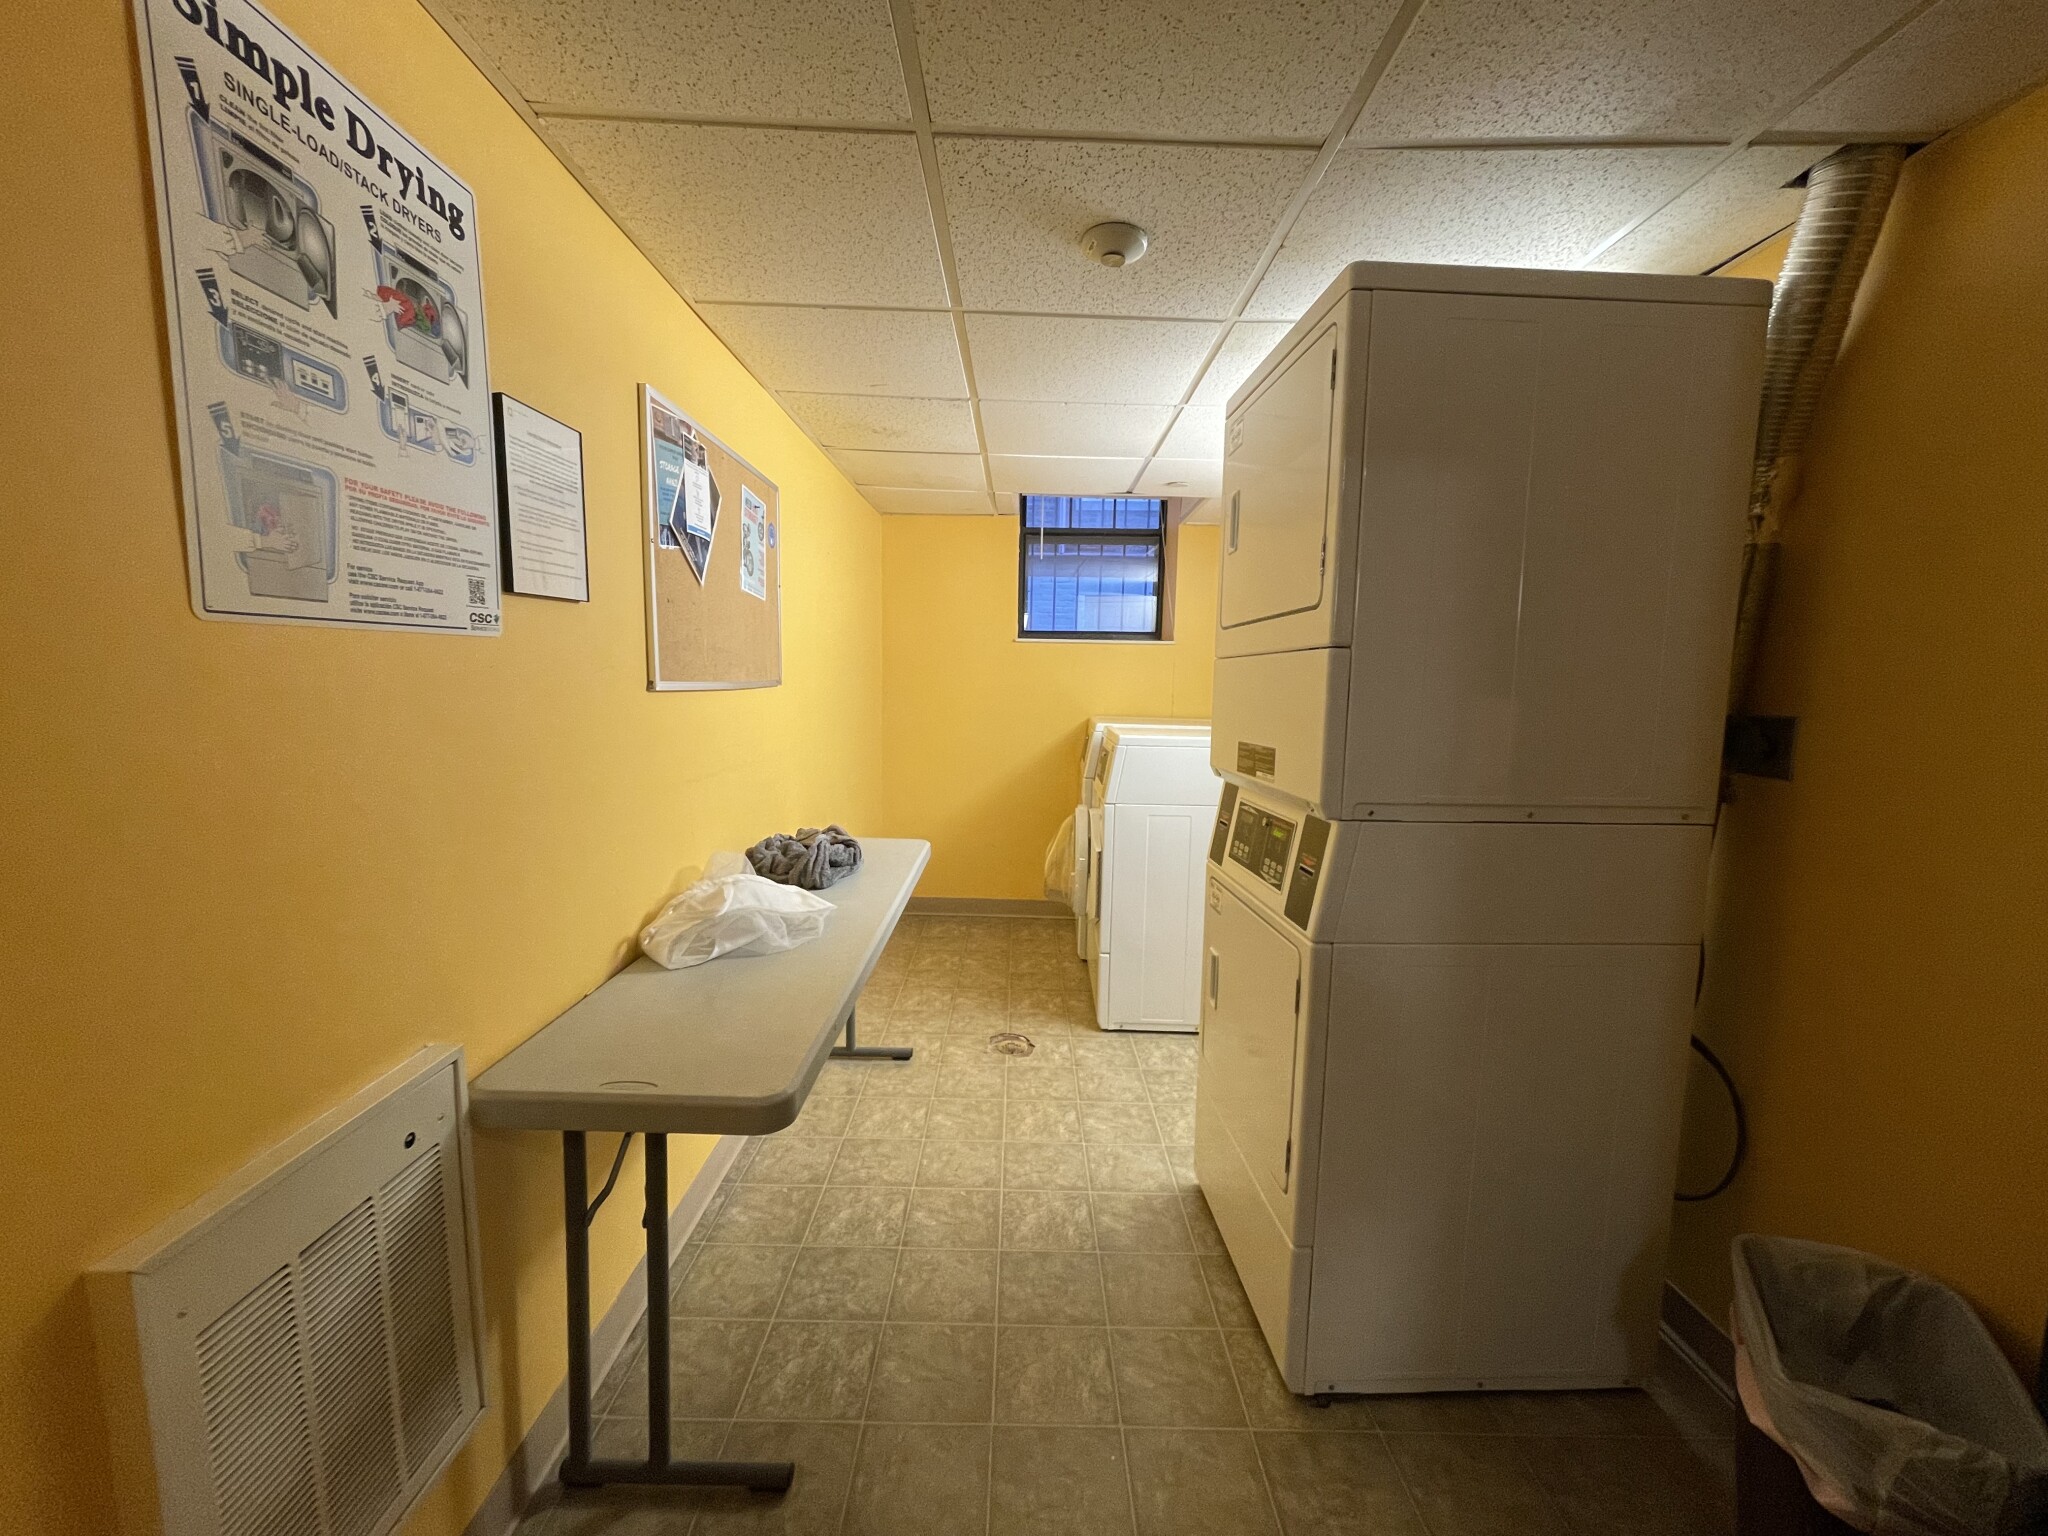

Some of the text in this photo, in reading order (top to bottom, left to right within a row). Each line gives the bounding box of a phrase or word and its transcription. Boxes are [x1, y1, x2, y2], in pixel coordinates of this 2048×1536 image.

[224, 71, 389, 207] SINGLE-LOAD/STACK
[393, 198, 441, 243] DRYERS
[344, 105, 465, 241] Drying
[209, 288, 222, 307] 3
[220, 422, 232, 438] 5
[345, 477, 358, 485] FOR
[361, 482, 378, 491] YOUR
[380, 487, 403, 498] SAFETY
[404, 494, 427, 505] PLEASE
[470, 612, 493, 624] CSC
